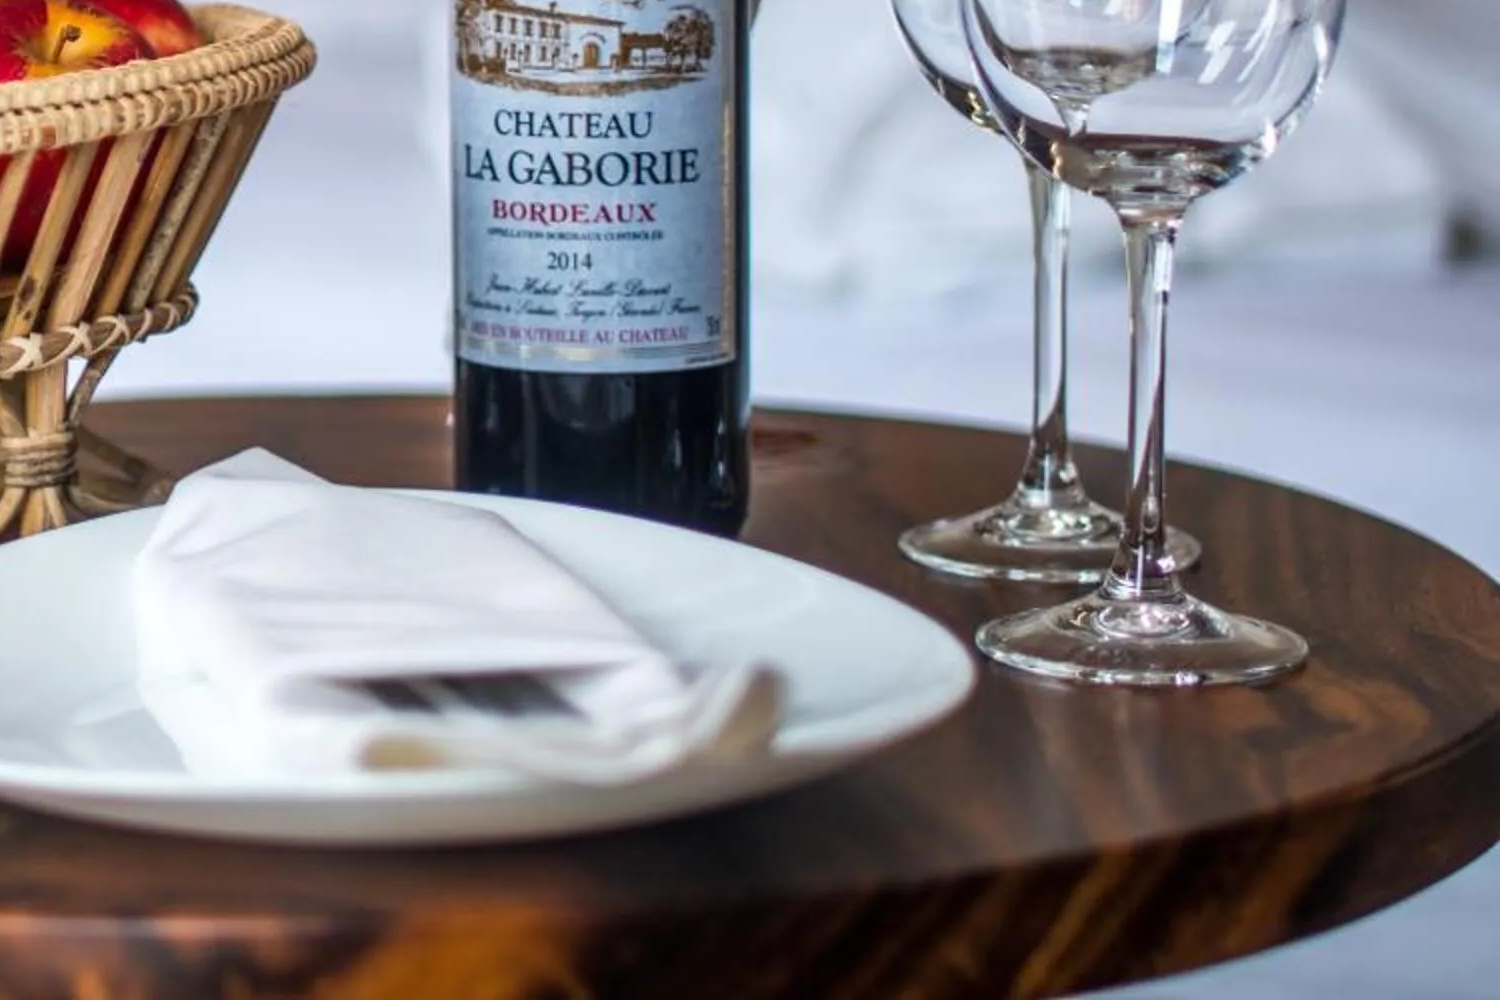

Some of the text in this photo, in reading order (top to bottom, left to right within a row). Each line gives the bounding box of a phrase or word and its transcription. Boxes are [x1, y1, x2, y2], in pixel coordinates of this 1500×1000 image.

[494, 109, 654, 139] CHATEAU
[463, 143, 700, 187] LA GABORIE
[490, 198, 658, 226] BORDEAUX
[547, 251, 593, 271] 2014
